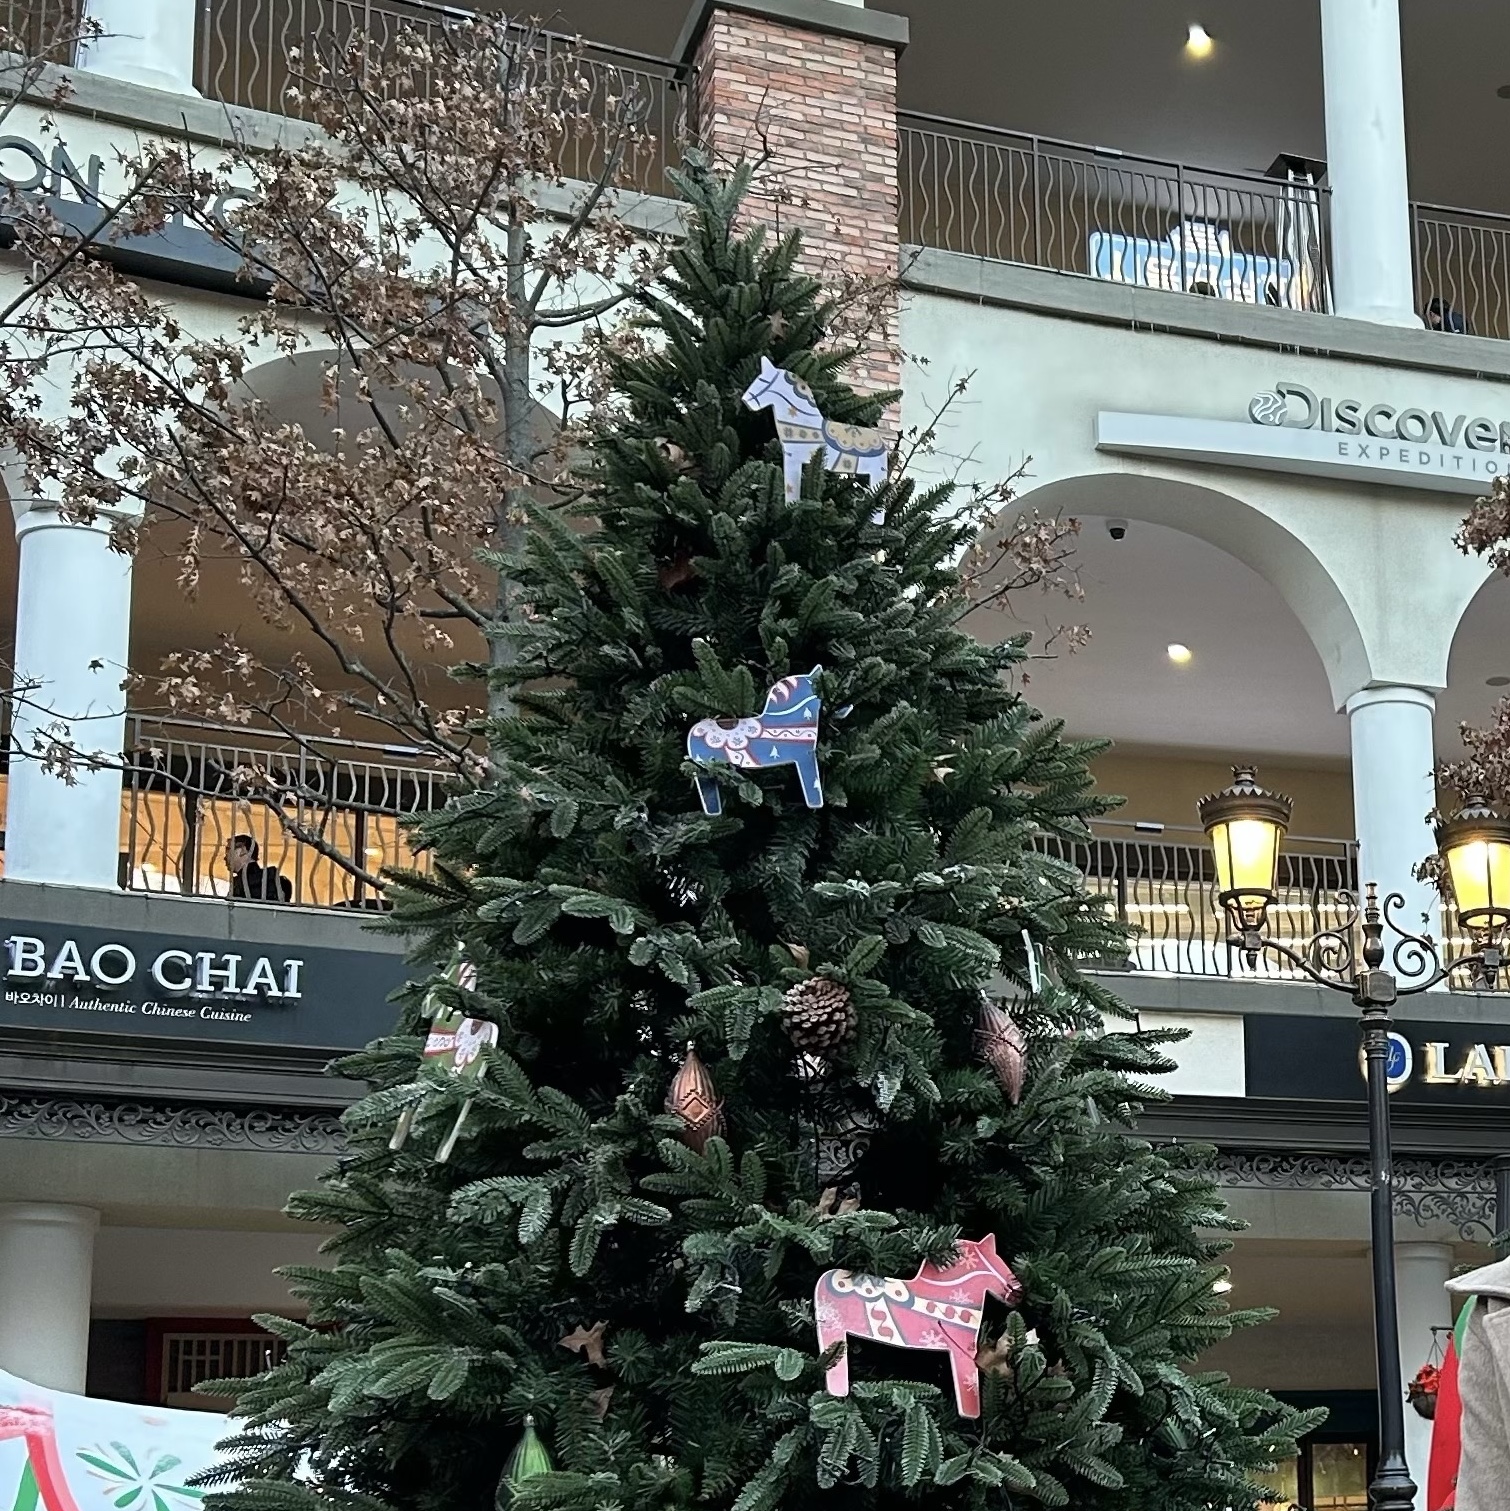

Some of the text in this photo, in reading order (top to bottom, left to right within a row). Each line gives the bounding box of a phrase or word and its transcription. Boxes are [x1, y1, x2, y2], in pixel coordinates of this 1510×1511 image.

[7, 935, 304, 998] BAO CHAI
[5, 991, 57, 1008] 바오차이
[68, 996, 252, 1022] Authentic Chinese Cuisine
